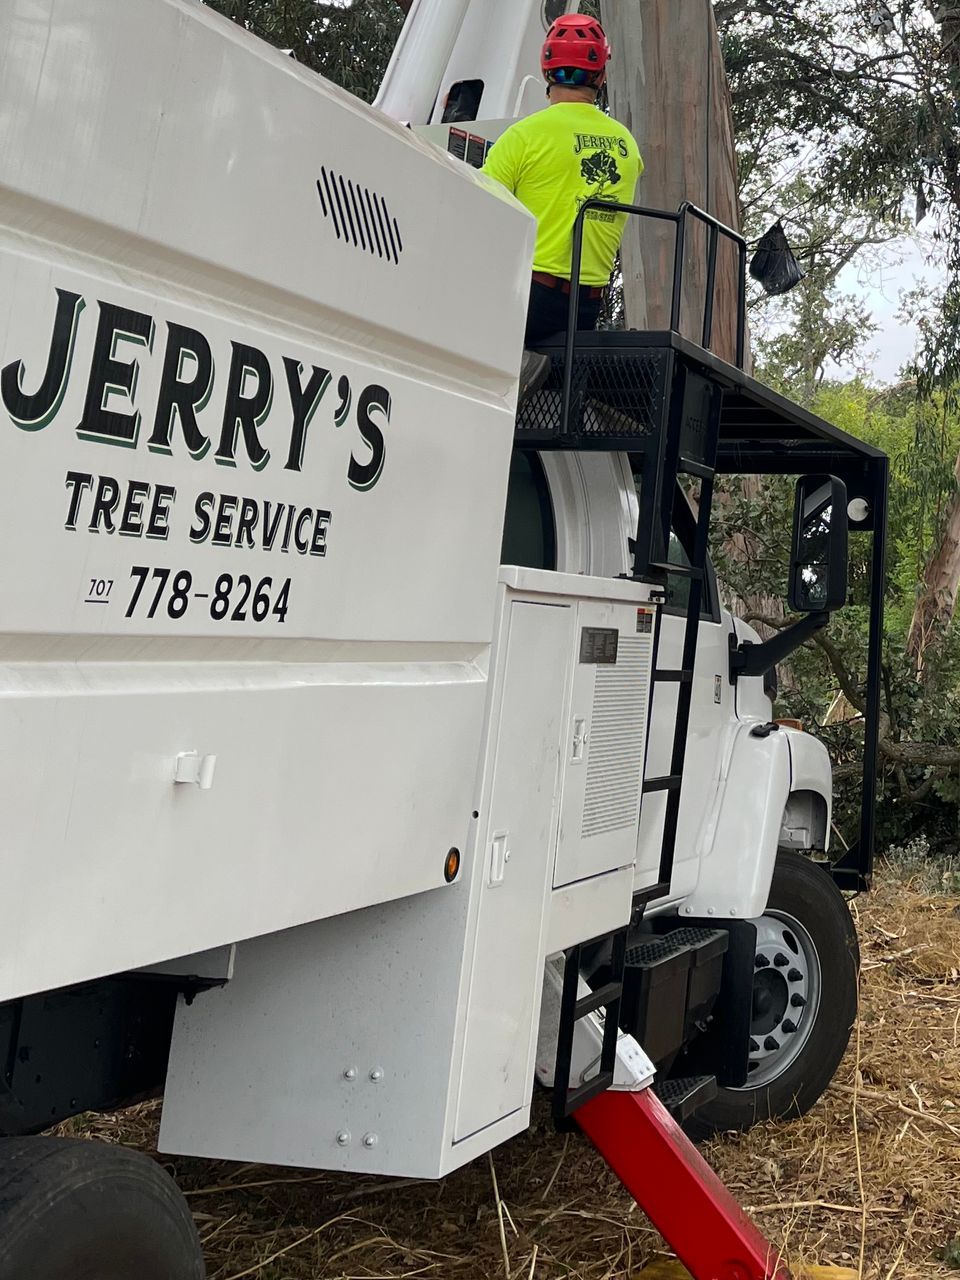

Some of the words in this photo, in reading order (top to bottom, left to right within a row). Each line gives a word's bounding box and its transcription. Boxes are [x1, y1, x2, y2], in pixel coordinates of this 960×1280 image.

[574, 133, 629, 158] JERRY'S
[0, 287, 392, 492] JERRY'S
[64, 470, 177, 541] TREE
[188, 491, 333, 558] SERVICE
[88, 578, 114, 598] 707
[124, 565, 292, 623] 778-8264
